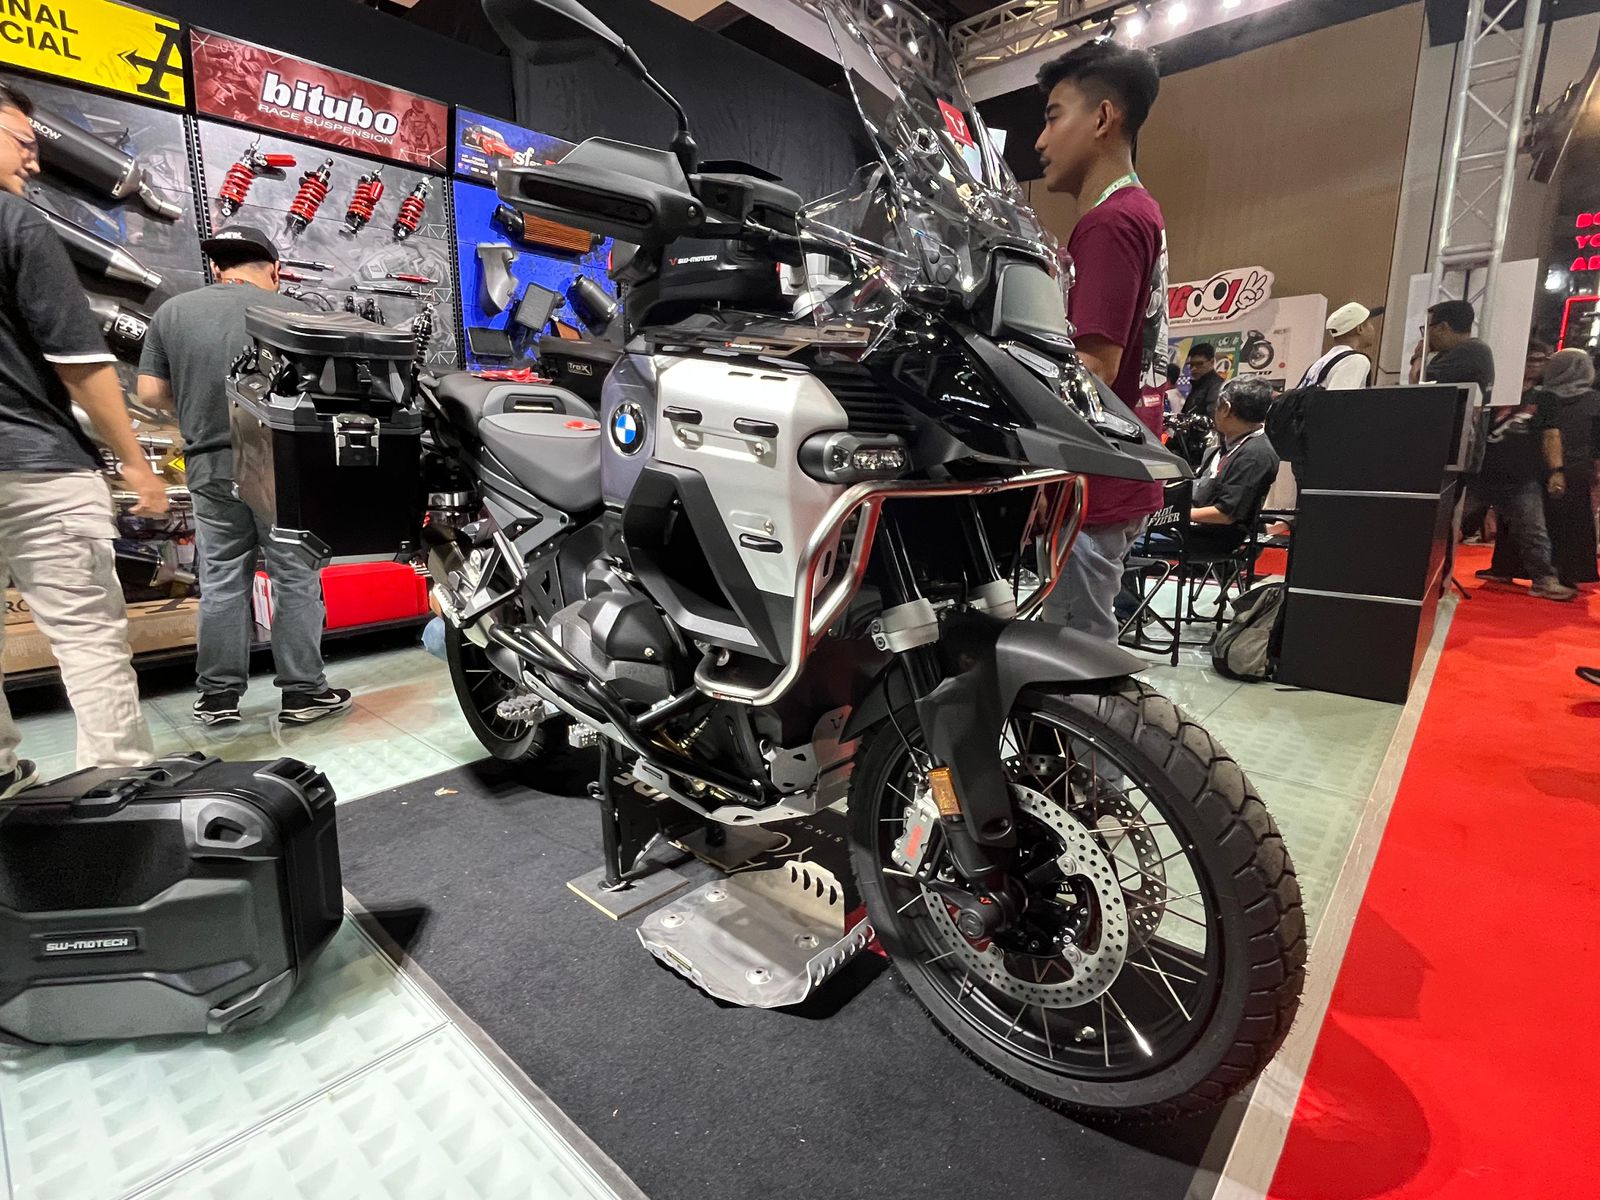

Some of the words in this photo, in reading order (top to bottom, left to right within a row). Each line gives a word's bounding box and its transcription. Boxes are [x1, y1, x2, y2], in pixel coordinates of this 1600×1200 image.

[261, 70, 398, 136] bitubo
[258, 104, 300, 121] RACE
[303, 115, 393, 145] SUSPENSION
[46, 938, 129, 952] SW-MOTECH
